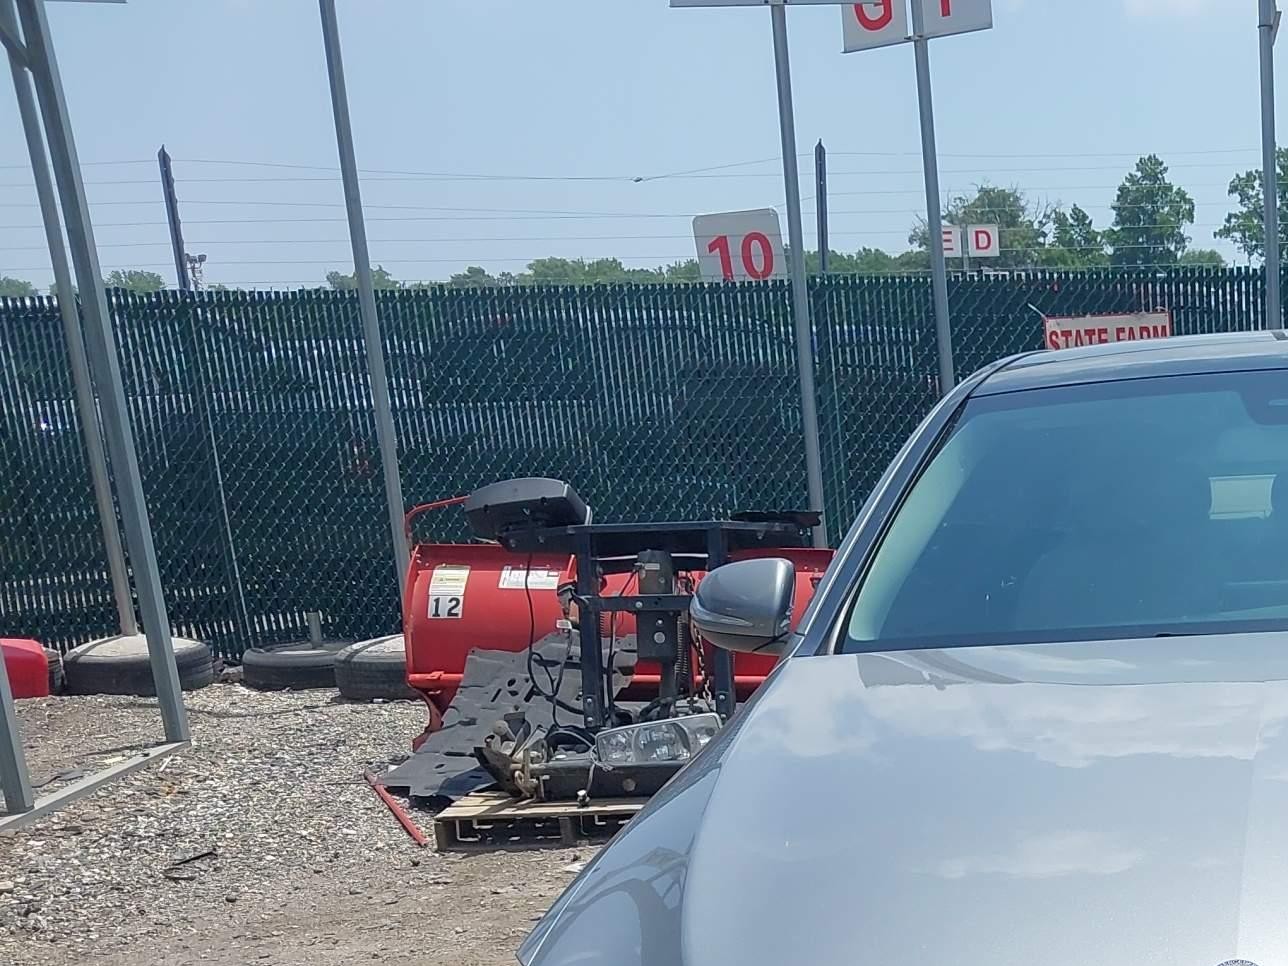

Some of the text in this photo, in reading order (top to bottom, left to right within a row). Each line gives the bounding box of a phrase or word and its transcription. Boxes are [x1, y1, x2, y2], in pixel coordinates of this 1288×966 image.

[974, 229, 992, 250] D
[707, 232, 773, 281] 10
[1048, 327, 1108, 350] STATE
[431, 596, 461, 618] 12
